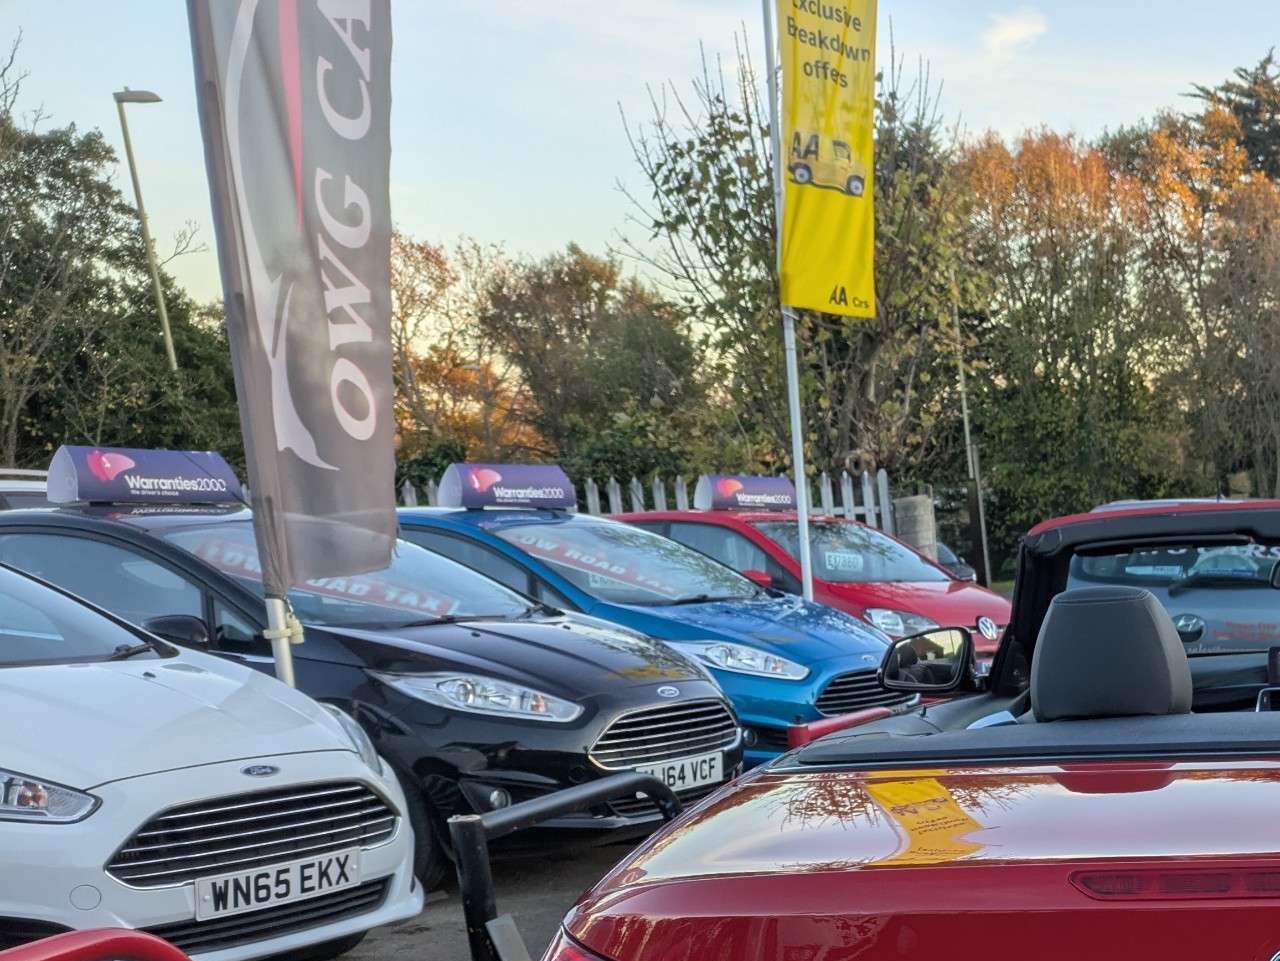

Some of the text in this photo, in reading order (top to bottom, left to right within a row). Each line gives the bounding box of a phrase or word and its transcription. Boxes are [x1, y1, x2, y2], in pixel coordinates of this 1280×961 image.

[787, 16, 871, 62] Beakdwn
[803, 60, 849, 88] offes
[792, 131, 819, 161] AA
[315, 167, 377, 441] OWG
[829, 284, 848, 307] AA
[124, 475, 227, 491] Warranties2000
[304, 576, 373, 597] OAD
[644, 757, 716, 787] J64 VCF
[211, 855, 350, 912] WN65 EKX
